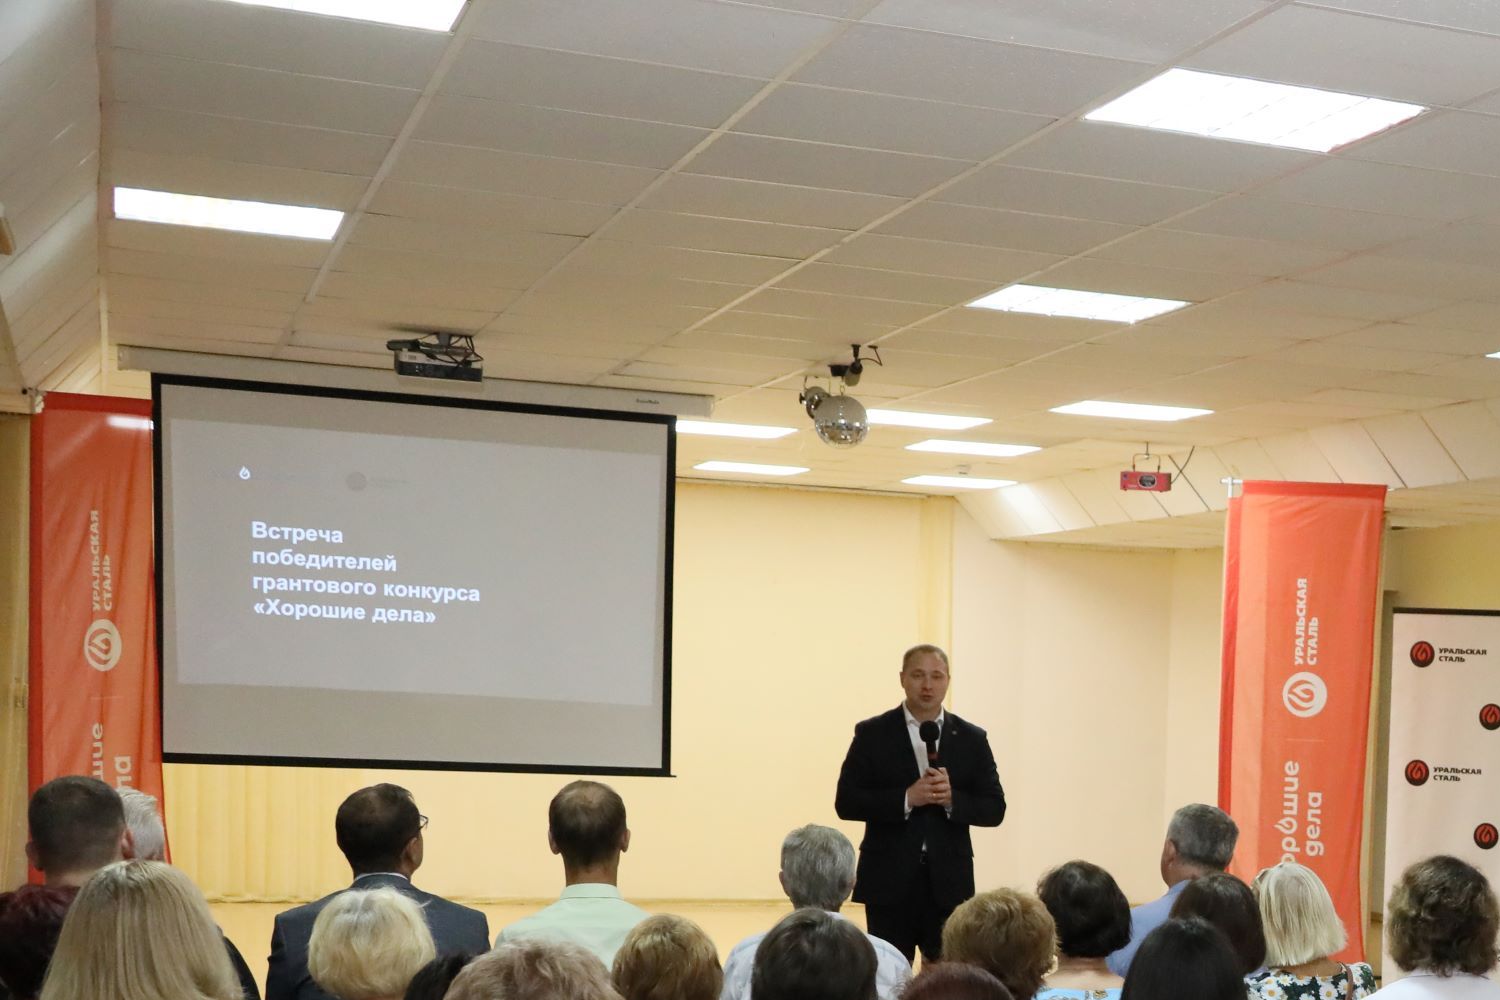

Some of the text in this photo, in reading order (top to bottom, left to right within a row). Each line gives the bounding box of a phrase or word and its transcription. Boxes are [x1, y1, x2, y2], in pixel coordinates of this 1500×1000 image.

[252, 521, 343, 544] Встреча
[90, 510, 99, 611] УРАЛЬСКАЯ
[252, 549, 396, 571] победителей
[103, 554, 111, 610] СТАЛЬ
[253, 576, 480, 603] грантового конкурса
[254, 598, 436, 623] «Хорошие дела»
[1295, 578, 1307, 664] УРАЛЬСКАЯ
[1307, 617, 1318, 665] СТАЛЬ
[1433, 767, 1482, 775] УРАЛЬСКАЯ
[1305, 791, 1324, 857] дела
